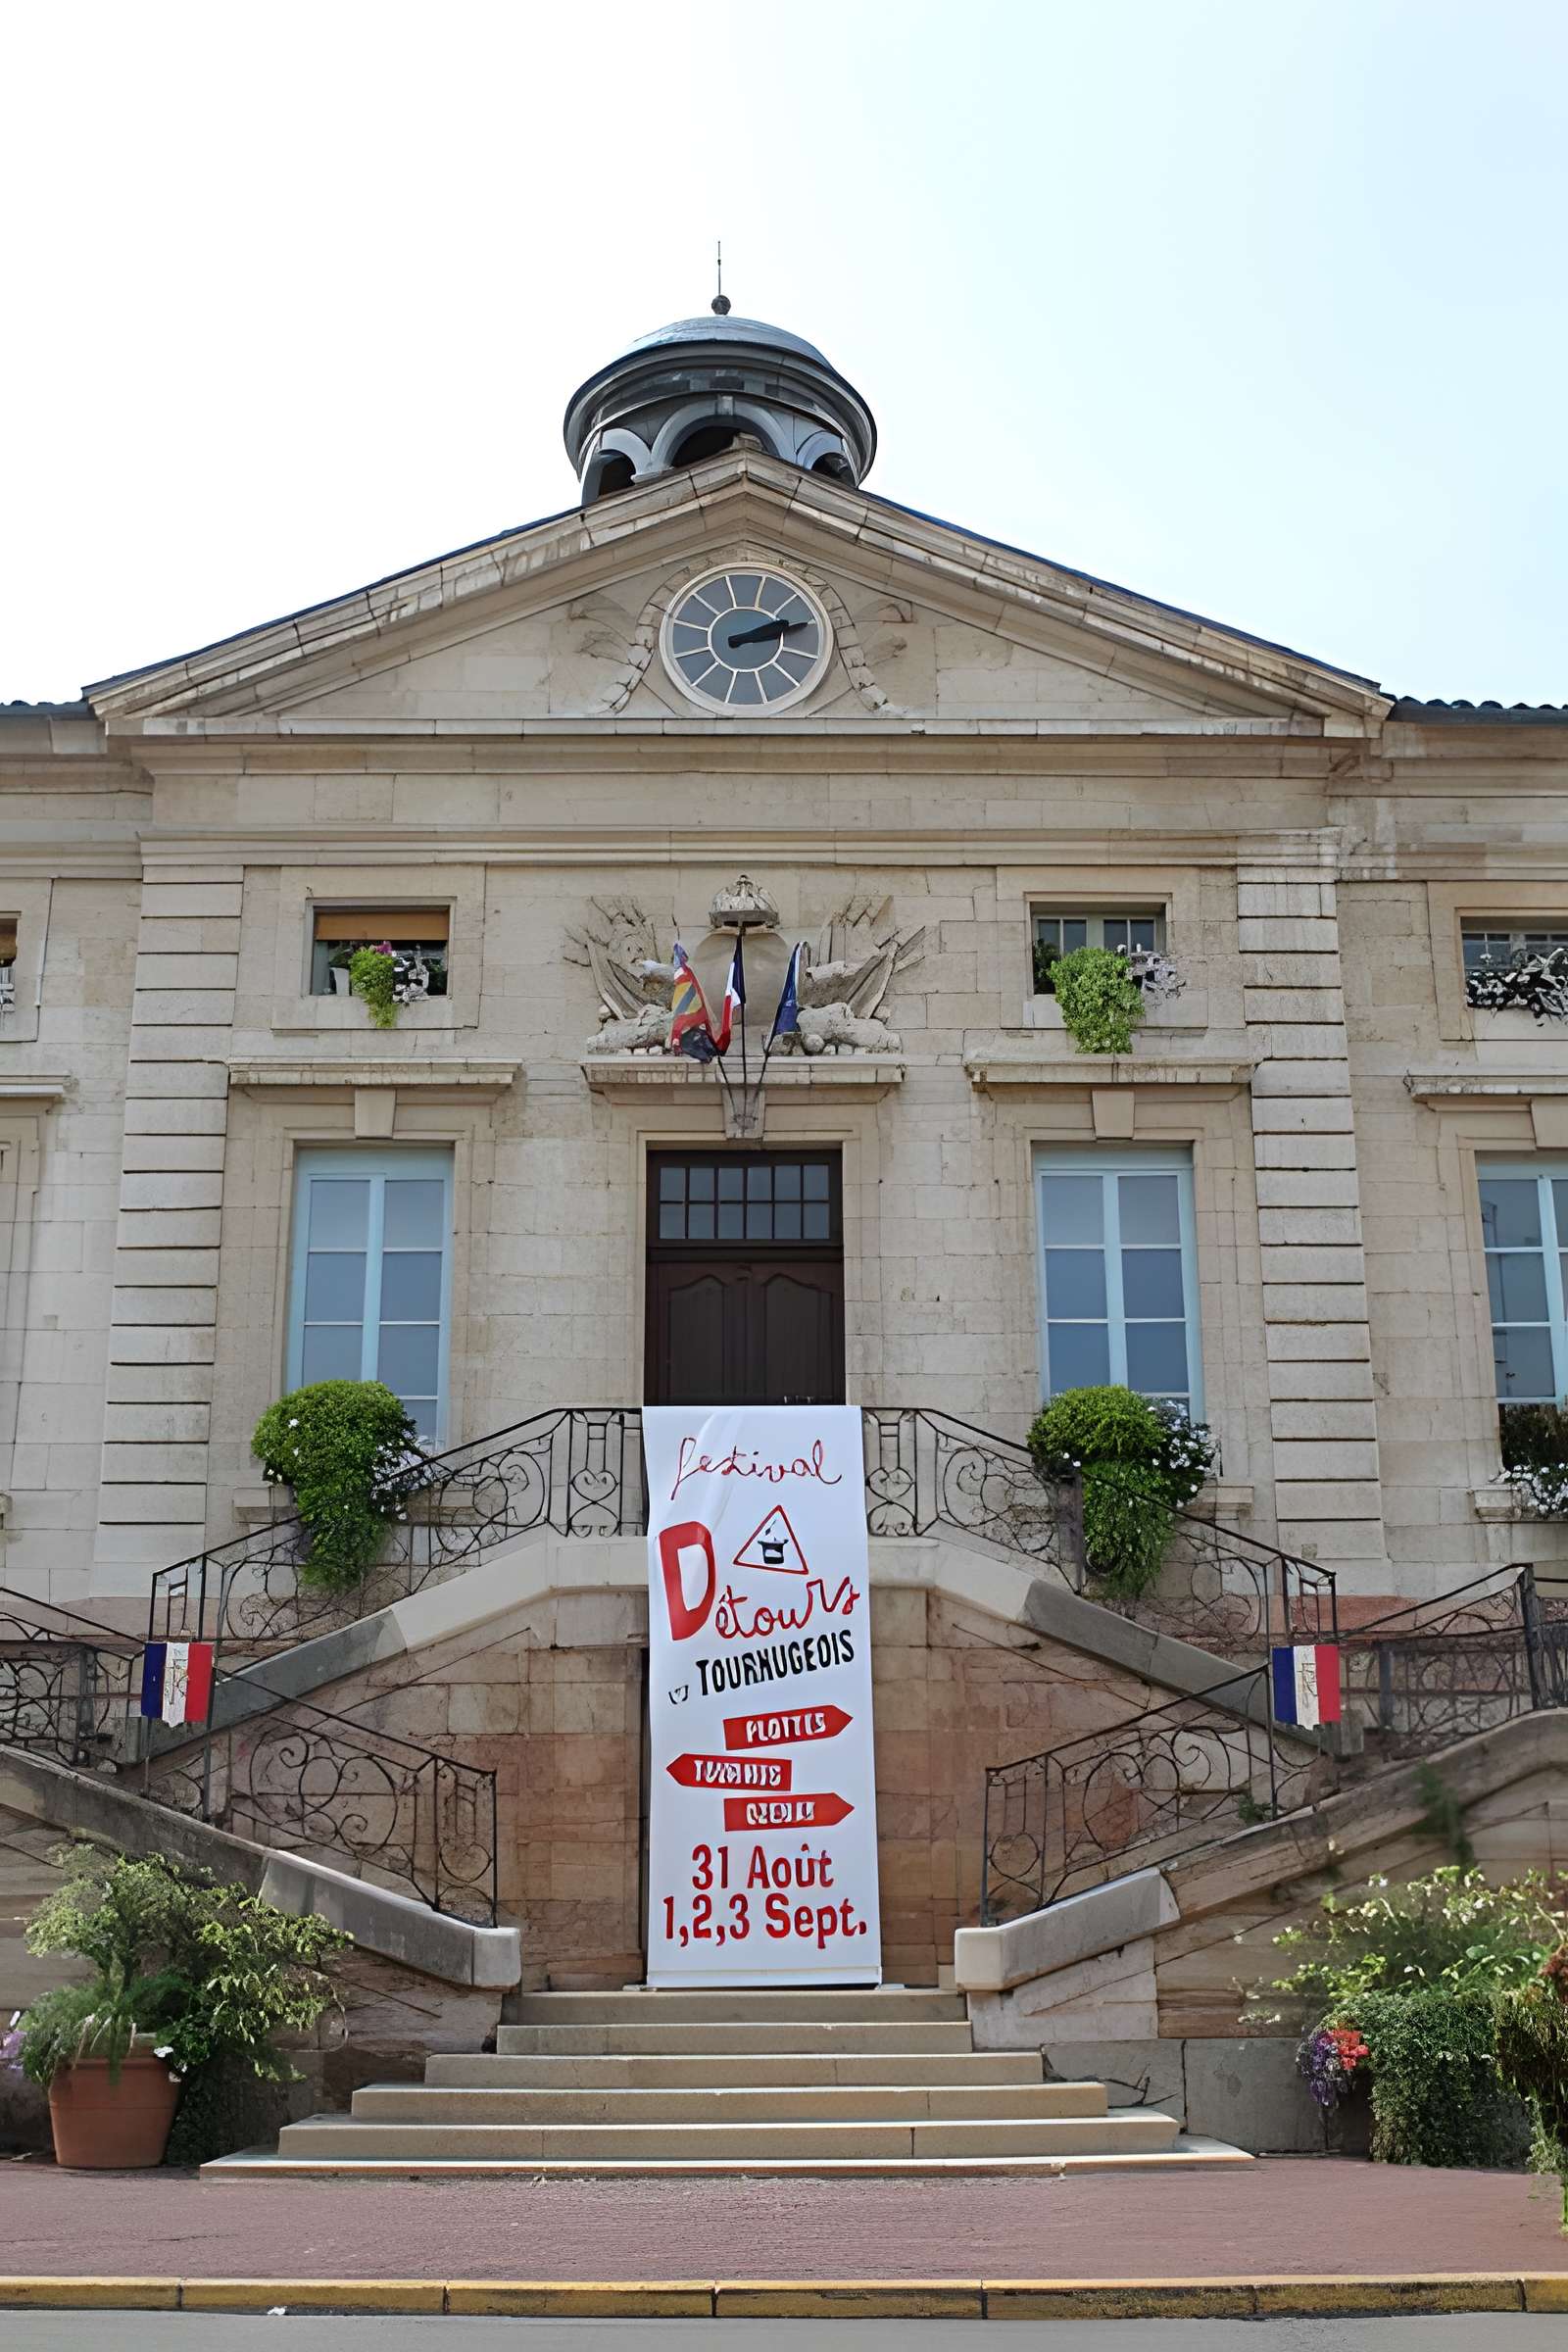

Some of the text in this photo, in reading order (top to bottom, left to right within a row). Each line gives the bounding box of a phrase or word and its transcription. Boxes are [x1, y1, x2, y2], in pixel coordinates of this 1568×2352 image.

[696, 1629, 855, 1696] TOURNUGEOIS
[692, 1842, 835, 1890] 31 Août
[663, 1892, 867, 1950] 1,2,3 Sept.
